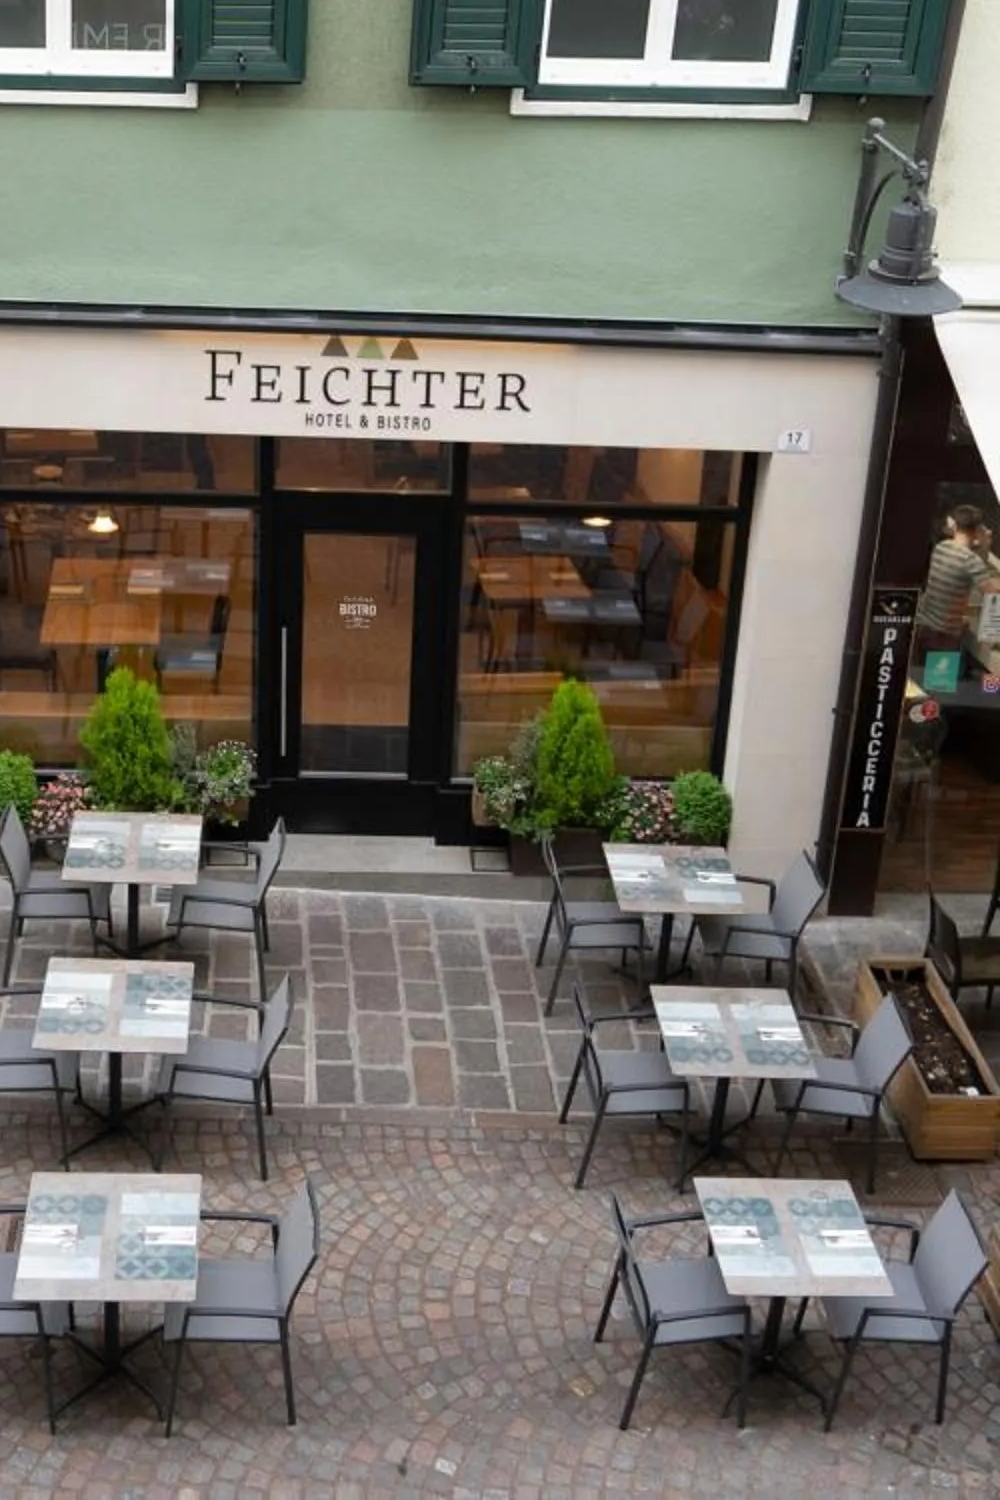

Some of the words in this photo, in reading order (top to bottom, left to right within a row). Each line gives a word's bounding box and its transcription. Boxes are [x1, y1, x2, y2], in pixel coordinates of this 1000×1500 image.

[204, 349, 532, 413] FEICHTER
[305, 412, 351, 429] HOTEL
[360, 414, 370, 430] &
[377, 415, 432, 432] BISTRO
[787, 431, 803, 445] 17
[339, 603, 377, 617] BISTRO
[855, 628, 898, 828] PASTICCERIA
